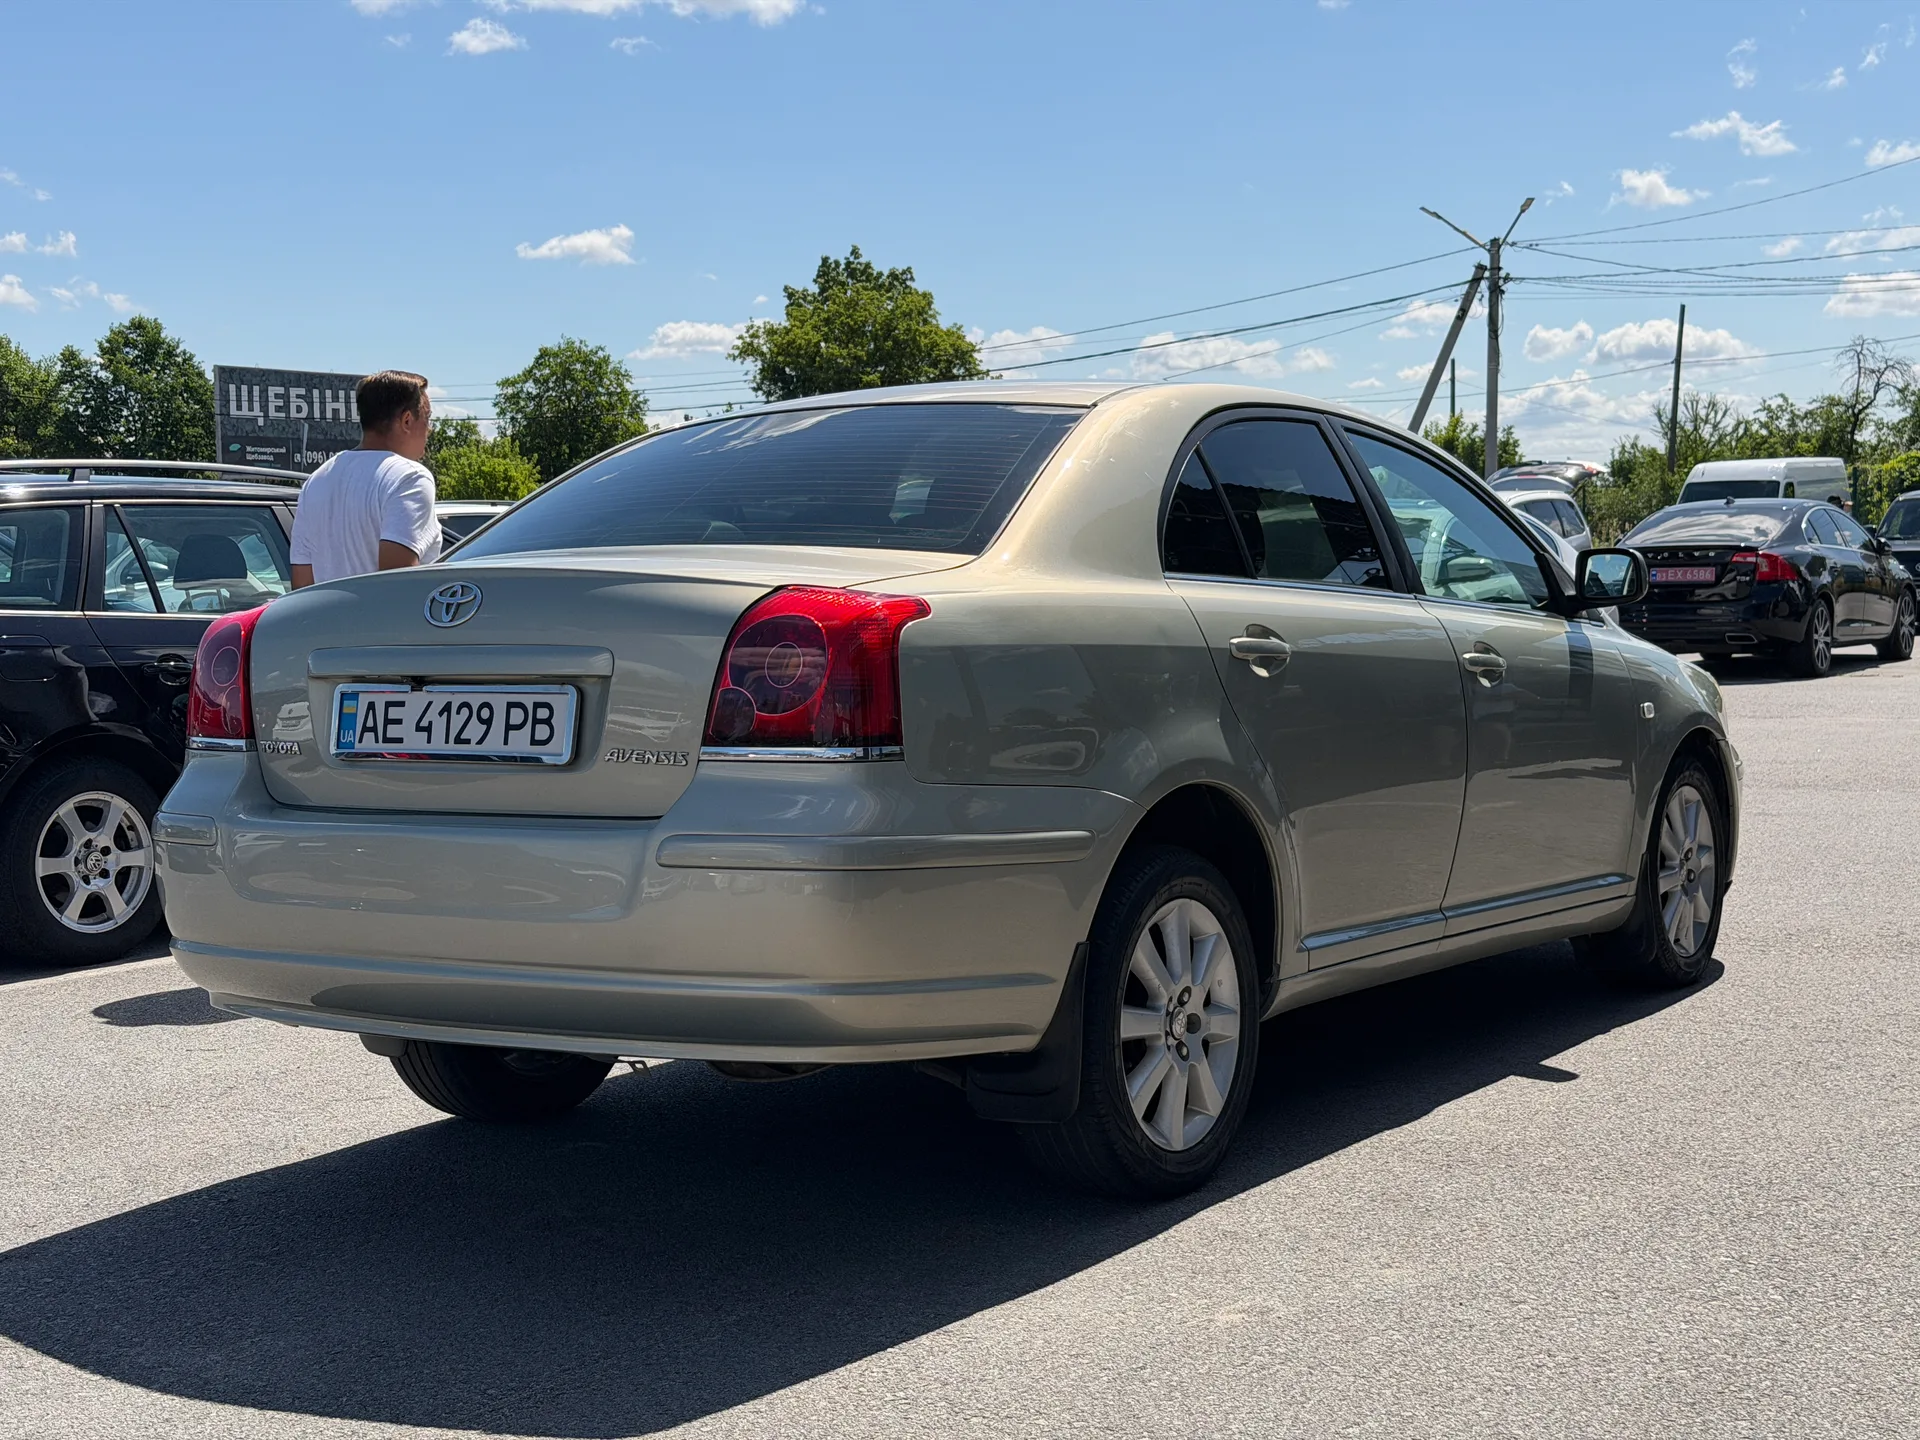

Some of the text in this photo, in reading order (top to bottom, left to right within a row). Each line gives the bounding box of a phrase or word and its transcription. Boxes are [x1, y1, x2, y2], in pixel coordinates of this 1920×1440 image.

[303, 450, 327, 467] (096)
[1668, 570, 1684, 580] EX
[358, 701, 555, 746] AE 4129 PB
[340, 729, 355, 743] UA
[260, 740, 302, 755] TOYOTA
[604, 748, 690, 766] AVENSIS
